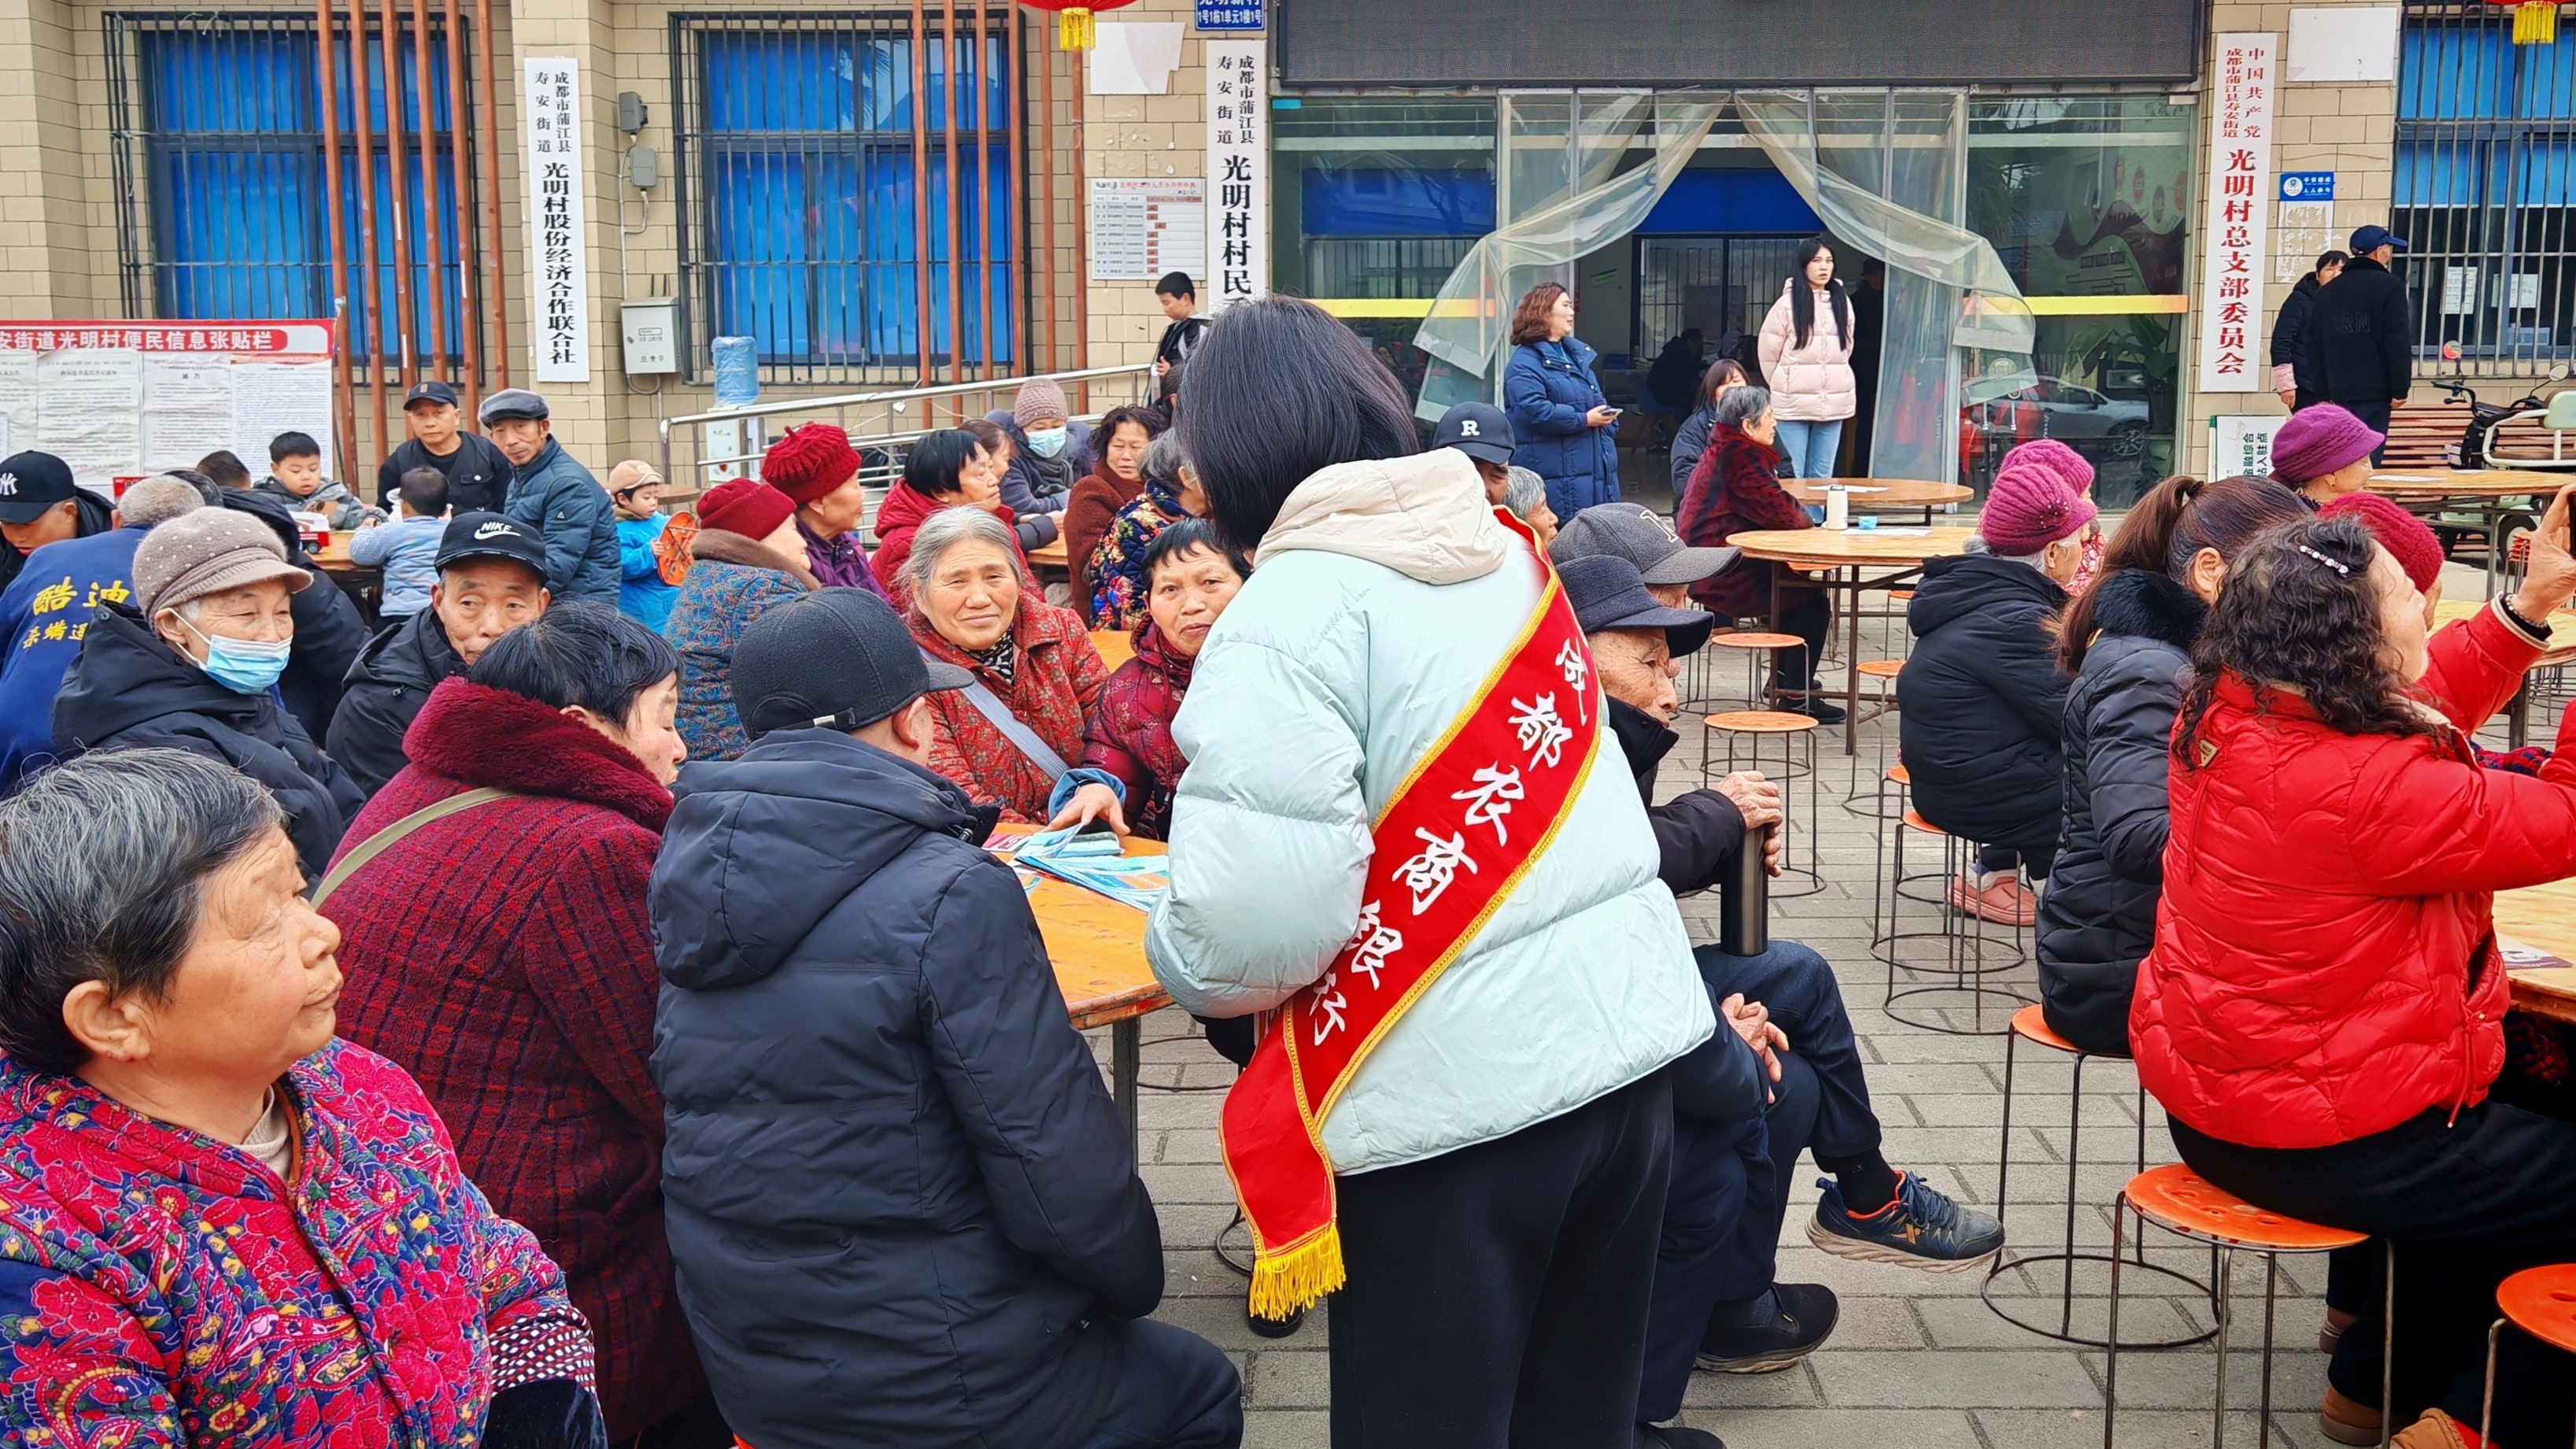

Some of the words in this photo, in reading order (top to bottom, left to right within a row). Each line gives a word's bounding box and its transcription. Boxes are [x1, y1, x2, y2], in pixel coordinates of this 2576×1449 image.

[534, 72, 553, 153] 寿安街道
[554, 71, 572, 153] 成都市蒲江县
[1217, 56, 1233, 145] 寿安街道
[1238, 55, 1256, 144] 成都市蒲江县
[2221, 47, 2243, 139] 成都市蒲江县寿安街道
[2243, 47, 2265, 139] 中国共产党
[541, 162, 577, 365] 光明村股份经济合作联合社
[1220, 155, 1253, 305] 光明村村民
[2215, 149, 2256, 375] 光明村总支部委员会
[1461, 420, 1480, 437] R
[481, 522, 512, 532] NIKE
[1309, 635, 1588, 1047] 成都农商银行
